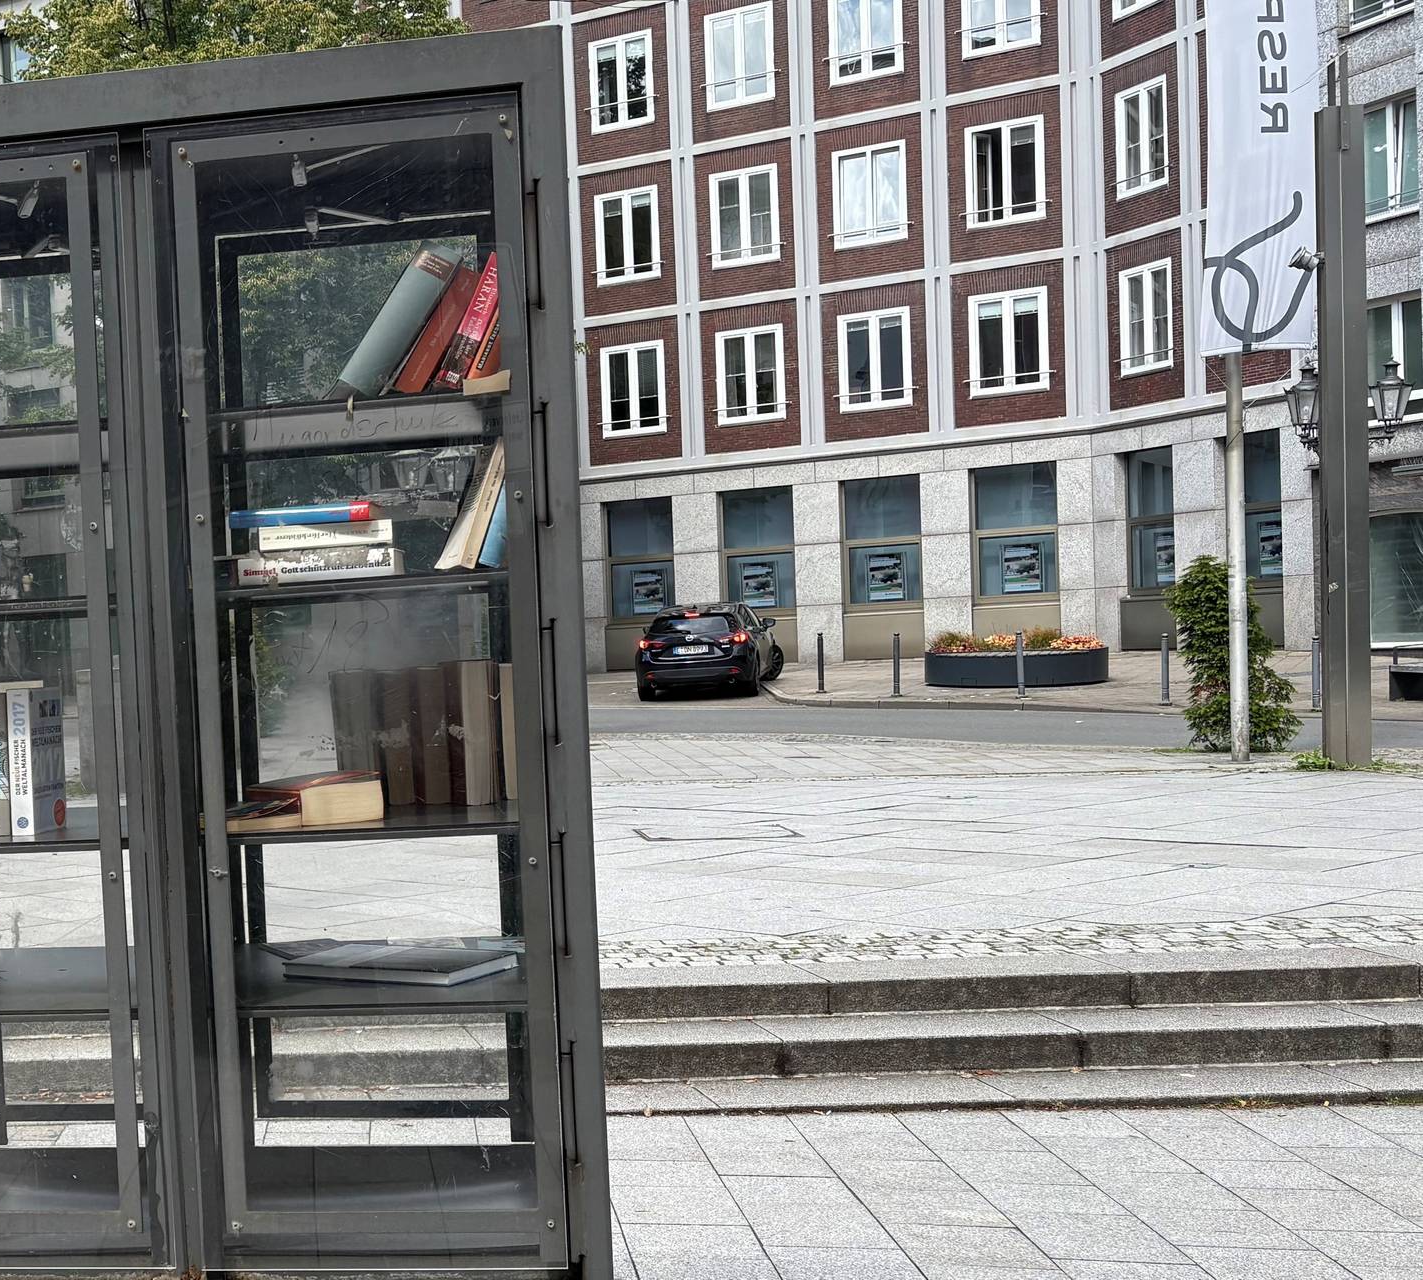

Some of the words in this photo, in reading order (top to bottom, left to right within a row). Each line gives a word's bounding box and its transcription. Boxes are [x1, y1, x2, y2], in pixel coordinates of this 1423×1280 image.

[473, 266, 497, 313] HARAN
[280, 566, 299, 575] Gott
[11, 702, 26, 736] 2017
[20, 739, 28, 796] WELTALMANACH
